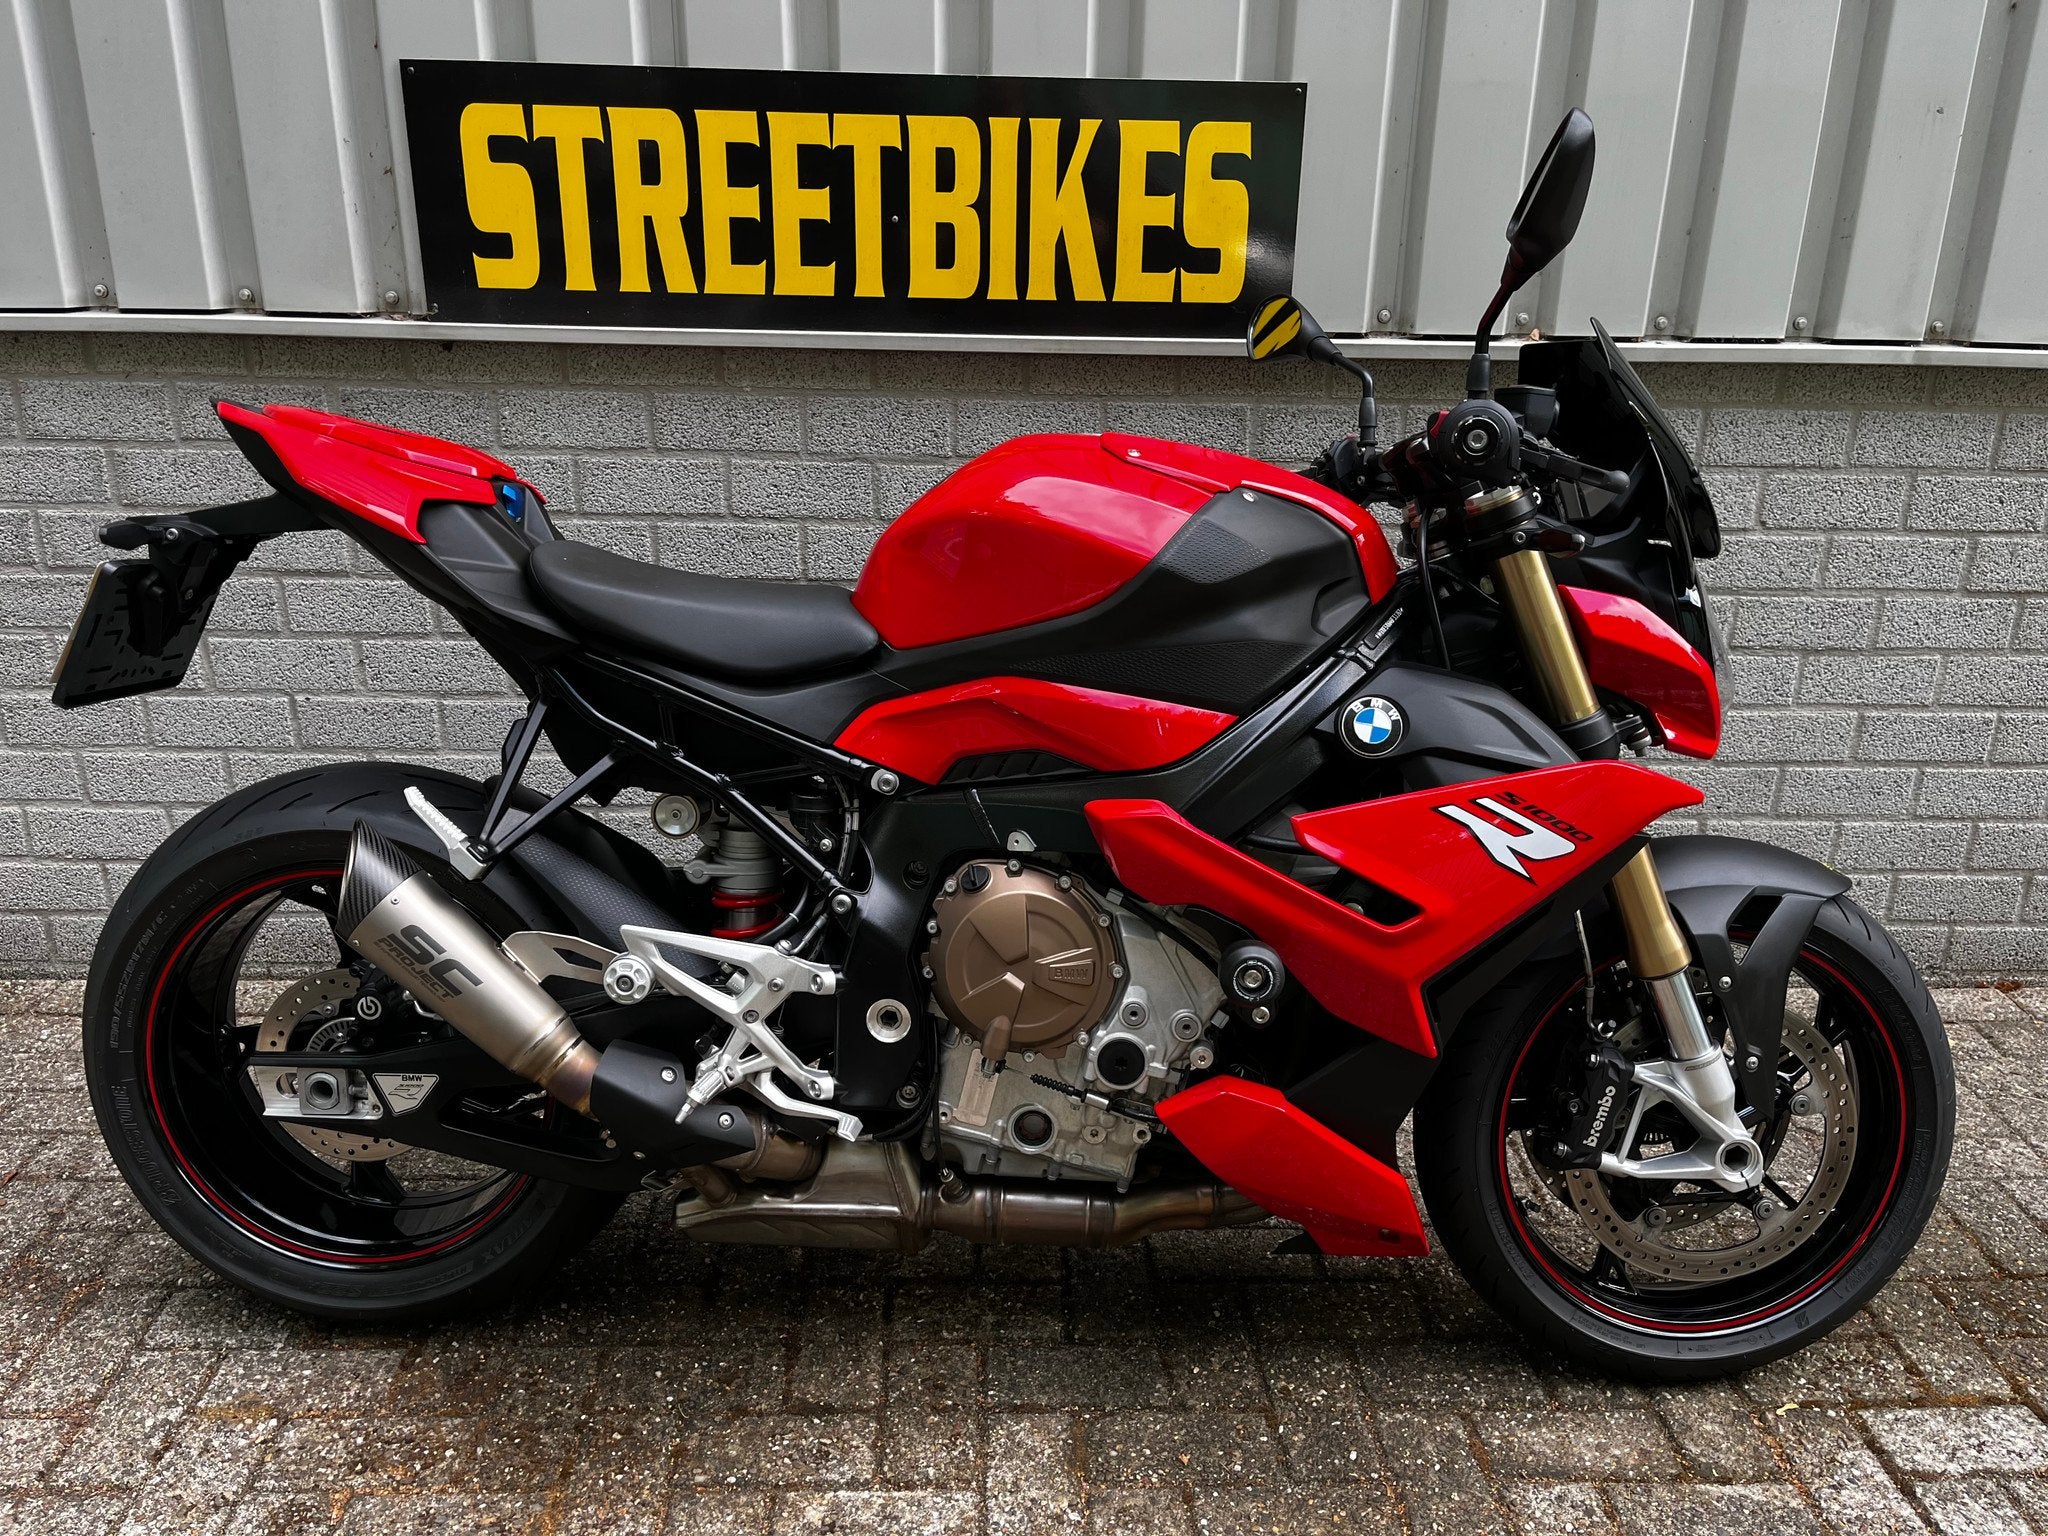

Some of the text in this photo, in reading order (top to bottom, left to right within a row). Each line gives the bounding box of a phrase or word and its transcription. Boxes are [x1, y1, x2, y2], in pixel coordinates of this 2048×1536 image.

[459, 102, 1252, 304] STREETBIKES
[1350, 697, 1400, 721] BMW
[377, 937, 456, 999] PROJECT
[386, 924, 484, 999] SC
[1053, 967, 1089, 981] BMW
[401, 1074, 423, 1082] BMW
[1582, 1085, 1616, 1148] brembo
